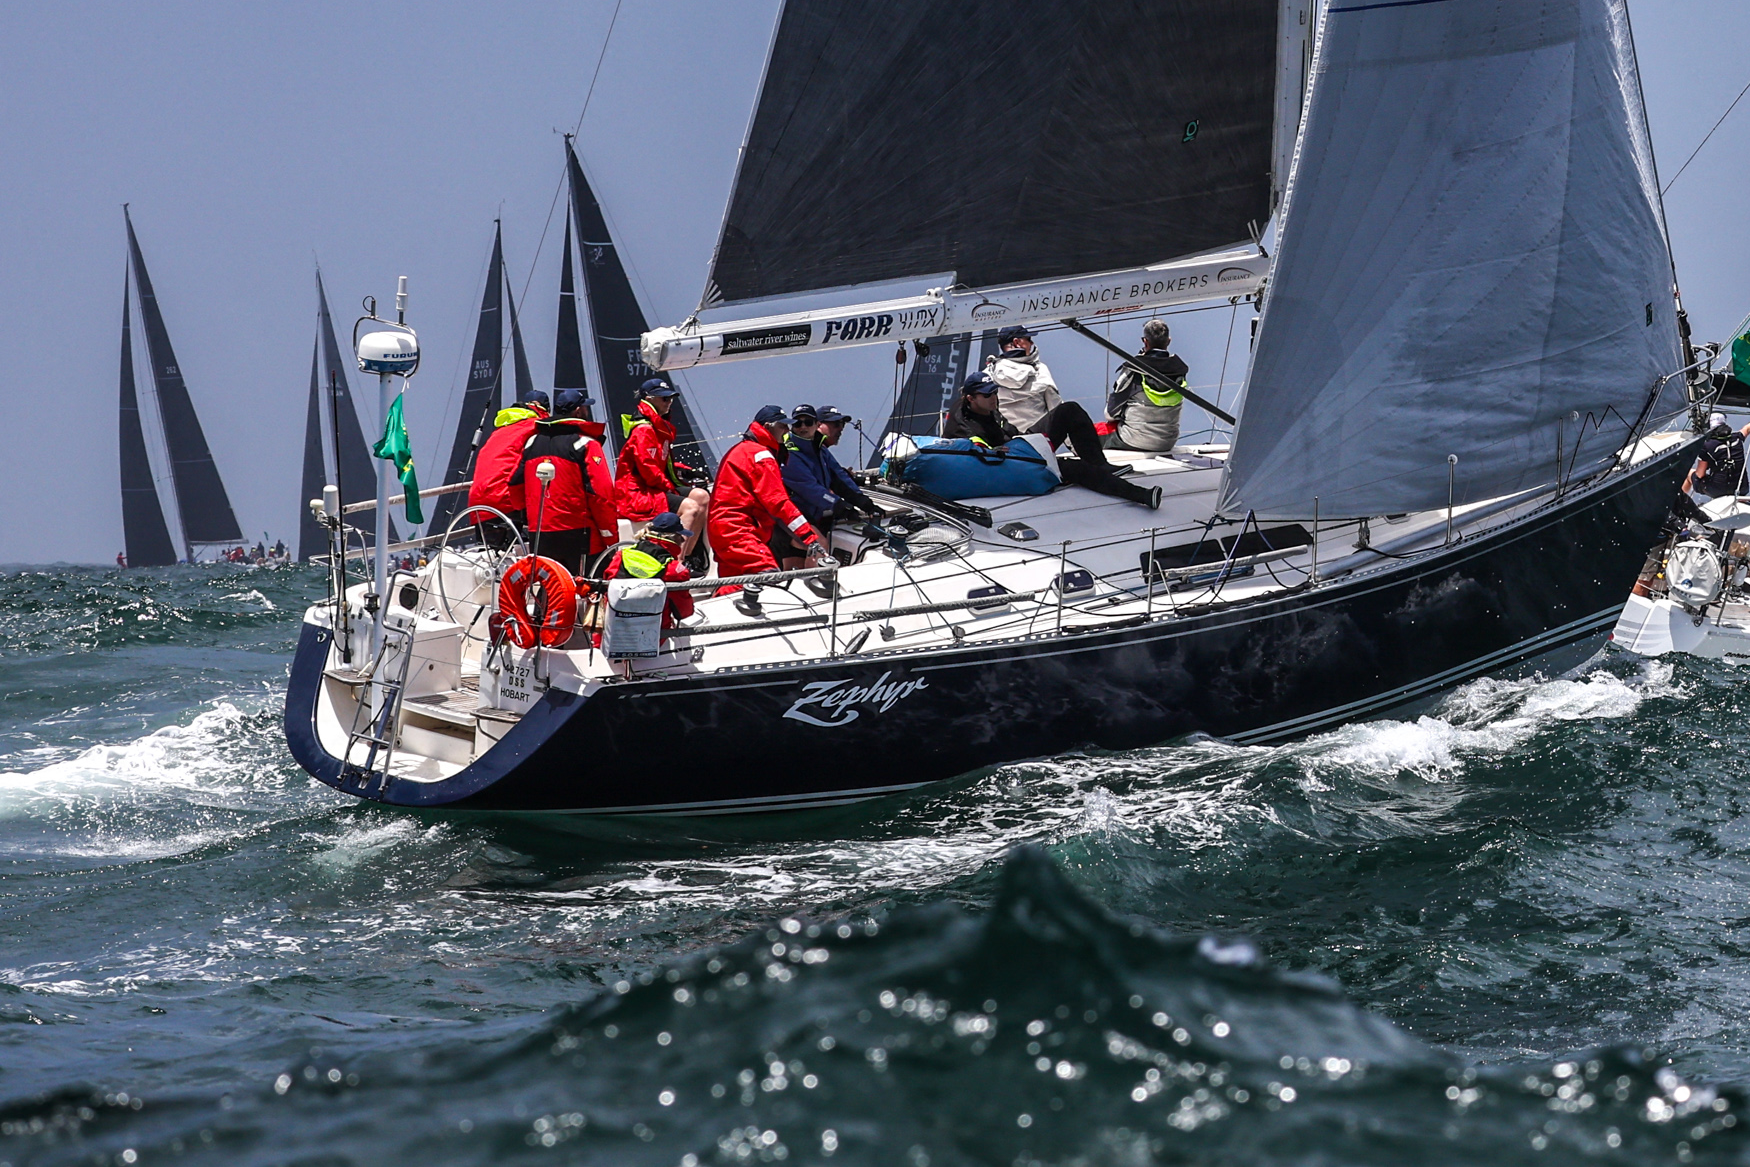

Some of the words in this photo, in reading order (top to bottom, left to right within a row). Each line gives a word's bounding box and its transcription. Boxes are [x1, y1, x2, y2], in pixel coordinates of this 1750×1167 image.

[1021, 286, 1121, 313] INSURANCE
[1129, 274, 1210, 298] BROKERS
[974, 309, 1006, 318] INSURANCE
[821, 314, 894, 344] FARR
[727, 337, 764, 349] saltwater
[764, 334, 783, 344] river
[784, 331, 807, 342] wines
[475, 359, 490, 370] AUS
[924, 354, 942, 364] USA
[928, 364, 937, 373] 16
[500, 687, 531, 703] HOBART
[781, 670, 930, 728] Zephyr
